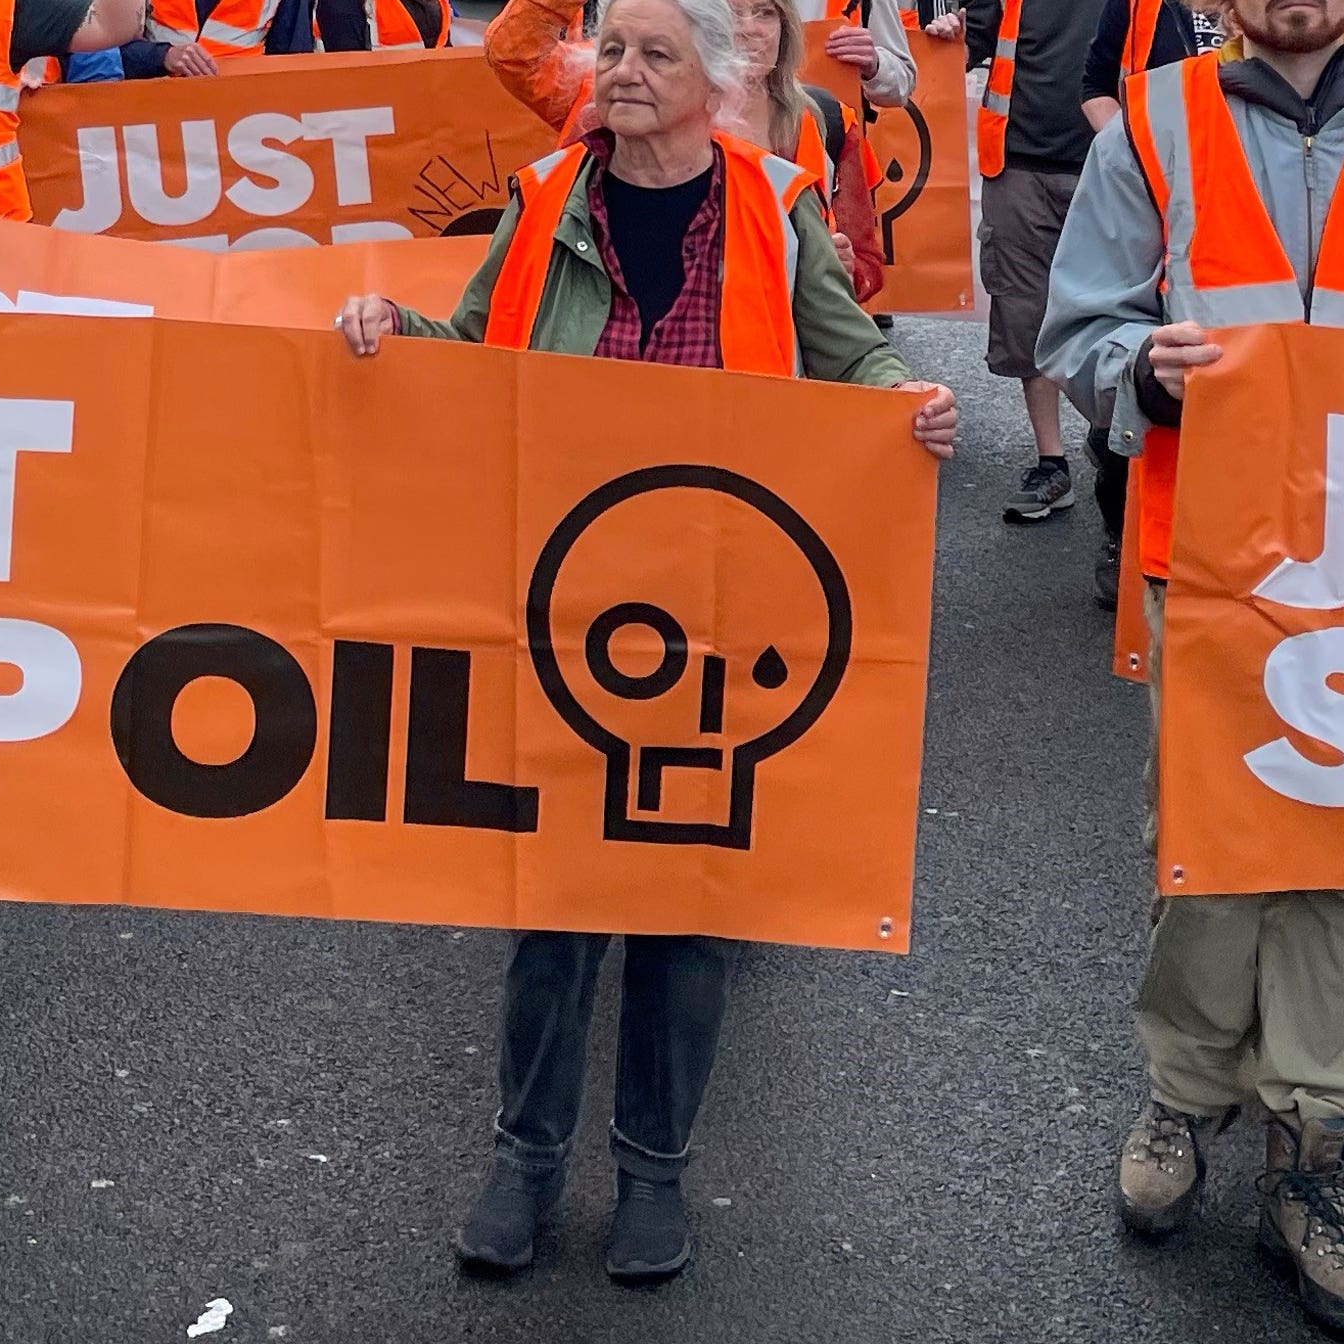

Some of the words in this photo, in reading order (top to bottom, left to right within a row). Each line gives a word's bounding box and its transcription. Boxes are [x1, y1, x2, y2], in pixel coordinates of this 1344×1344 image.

[52, 106, 395, 234] JUST
[409, 129, 502, 231] NEW
[110, 622, 540, 833] OIL
